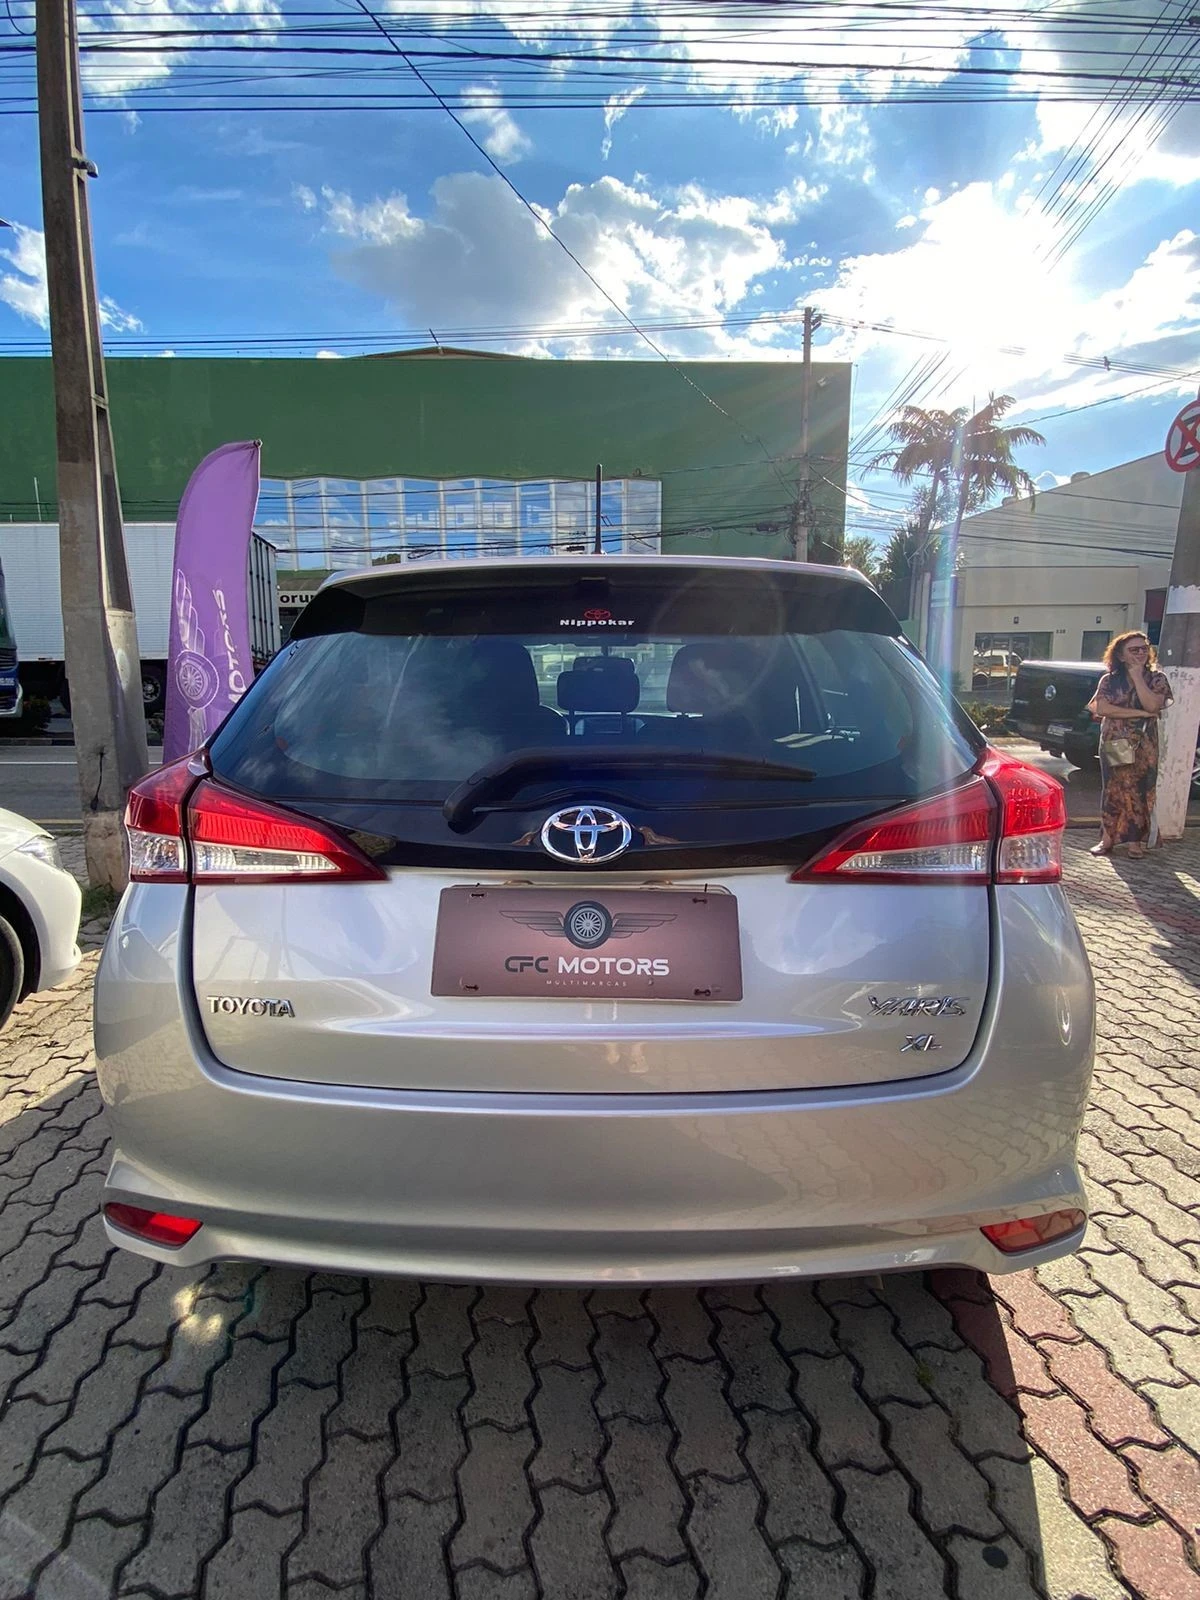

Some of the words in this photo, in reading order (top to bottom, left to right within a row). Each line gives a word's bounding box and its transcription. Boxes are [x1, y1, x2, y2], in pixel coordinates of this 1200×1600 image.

[279, 594, 316, 604] oru
[560, 619, 635, 627] Nippokar
[504, 956, 549, 973] CFC
[558, 957, 670, 976] MOTORS
[206, 995, 296, 1018] TOYOTA
[867, 995, 969, 1016] YARIS
[900, 1034, 943, 1052] XL
